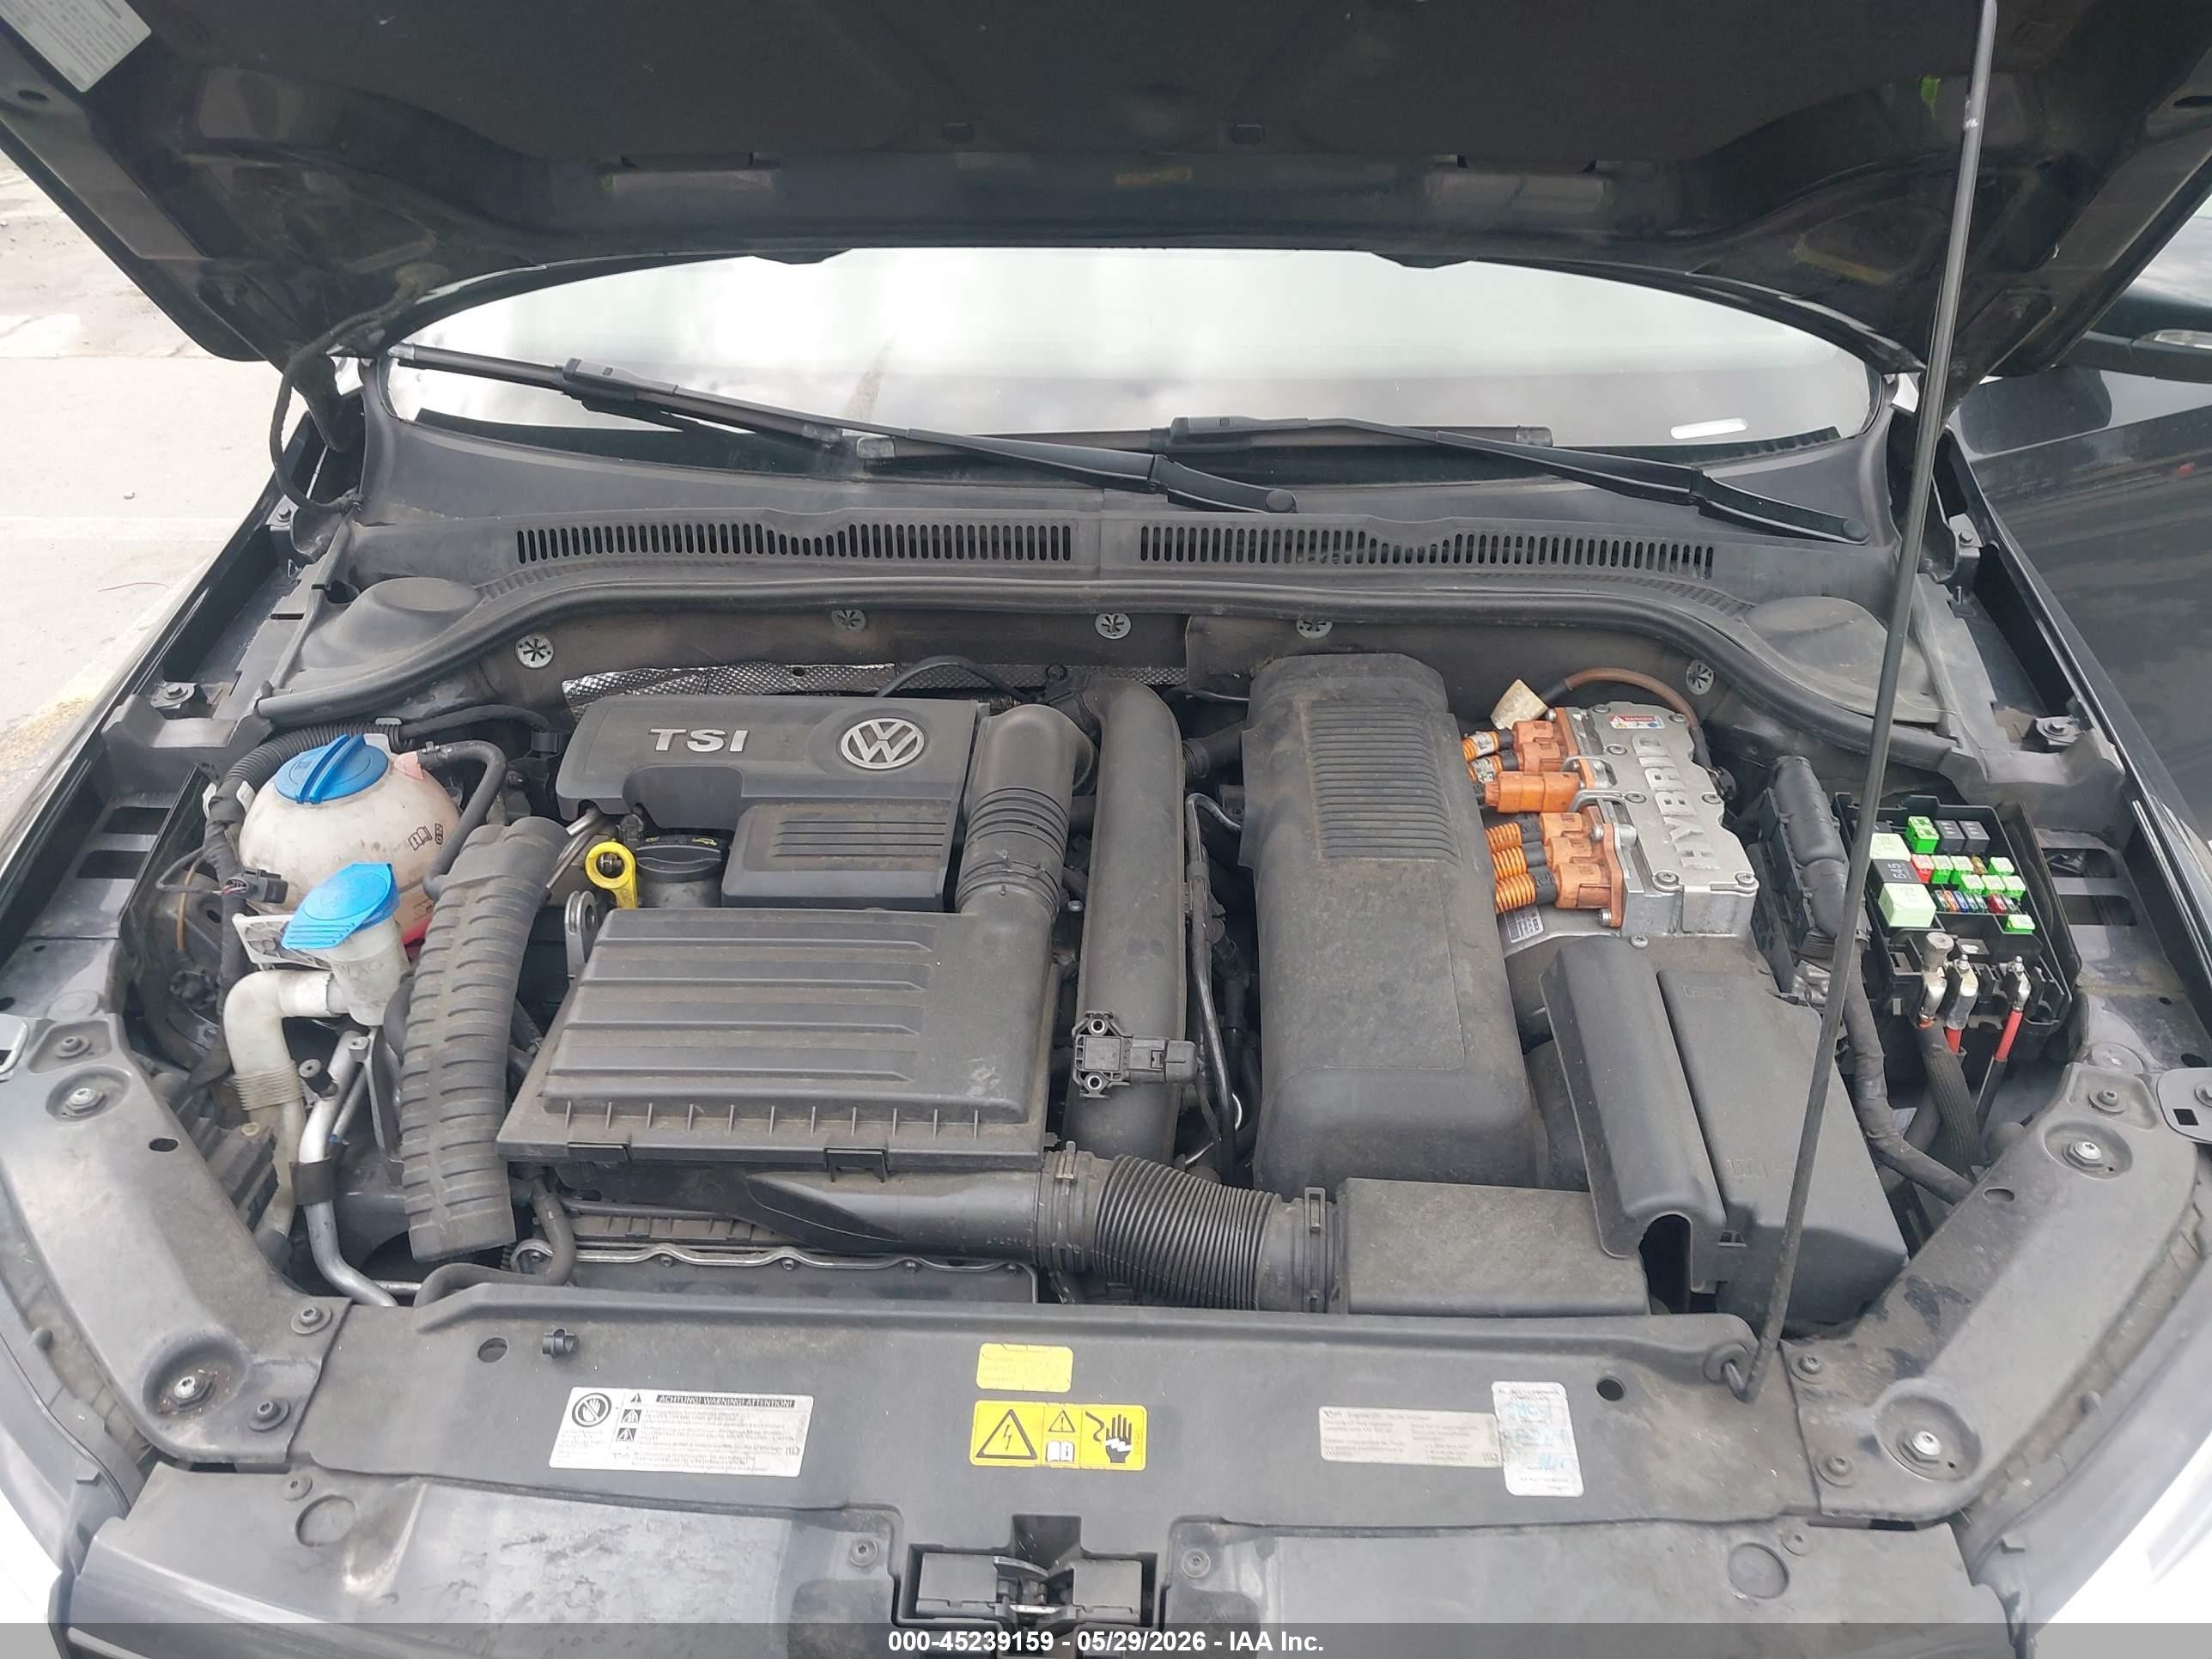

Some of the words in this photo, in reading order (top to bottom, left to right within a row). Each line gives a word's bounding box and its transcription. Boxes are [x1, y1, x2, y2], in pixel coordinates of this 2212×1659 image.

[650, 728, 748, 752] TSI
[1632, 733, 1722, 871] HYBRID
[1887, 863, 1906, 879] 645
